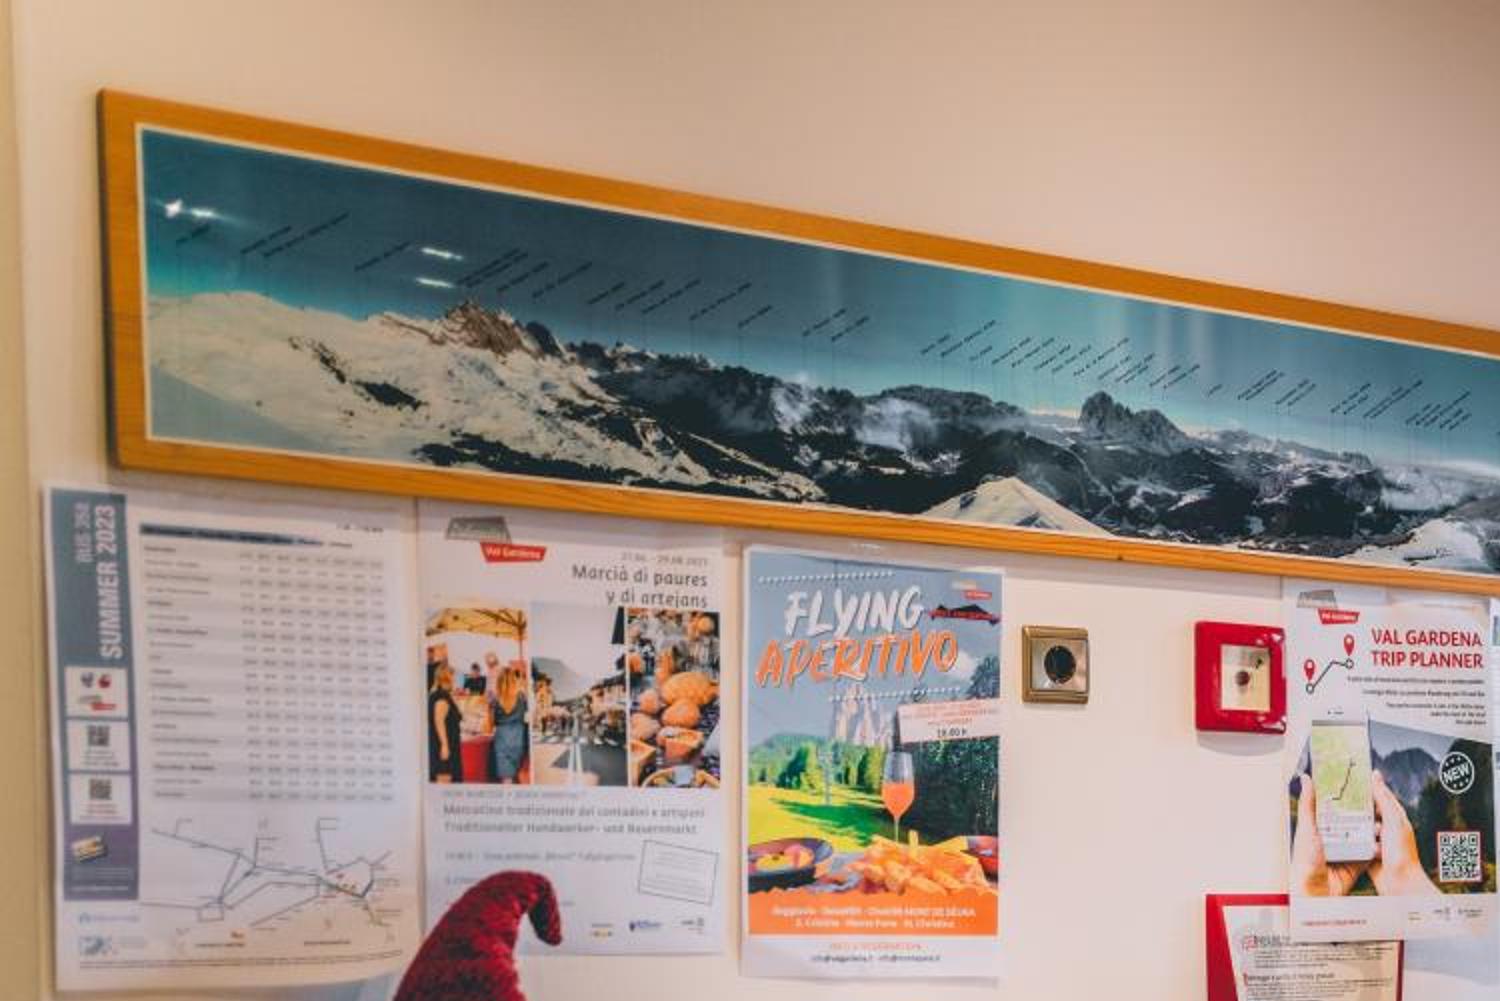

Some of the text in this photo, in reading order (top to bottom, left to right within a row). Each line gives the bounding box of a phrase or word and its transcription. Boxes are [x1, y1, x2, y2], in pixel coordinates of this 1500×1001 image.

[94, 504, 123, 660] SUMMER 2023
[571, 564, 708, 587] Marcià di paures
[605, 587, 708, 609] y di artejans
[784, 584, 924, 640] FLYING
[1371, 628, 1483, 648] VAL GARDENA
[755, 630, 959, 689] APERITIVO
[1371, 650, 1485, 669] TRIP PLANNER
[1442, 761, 1470, 785] NEW
